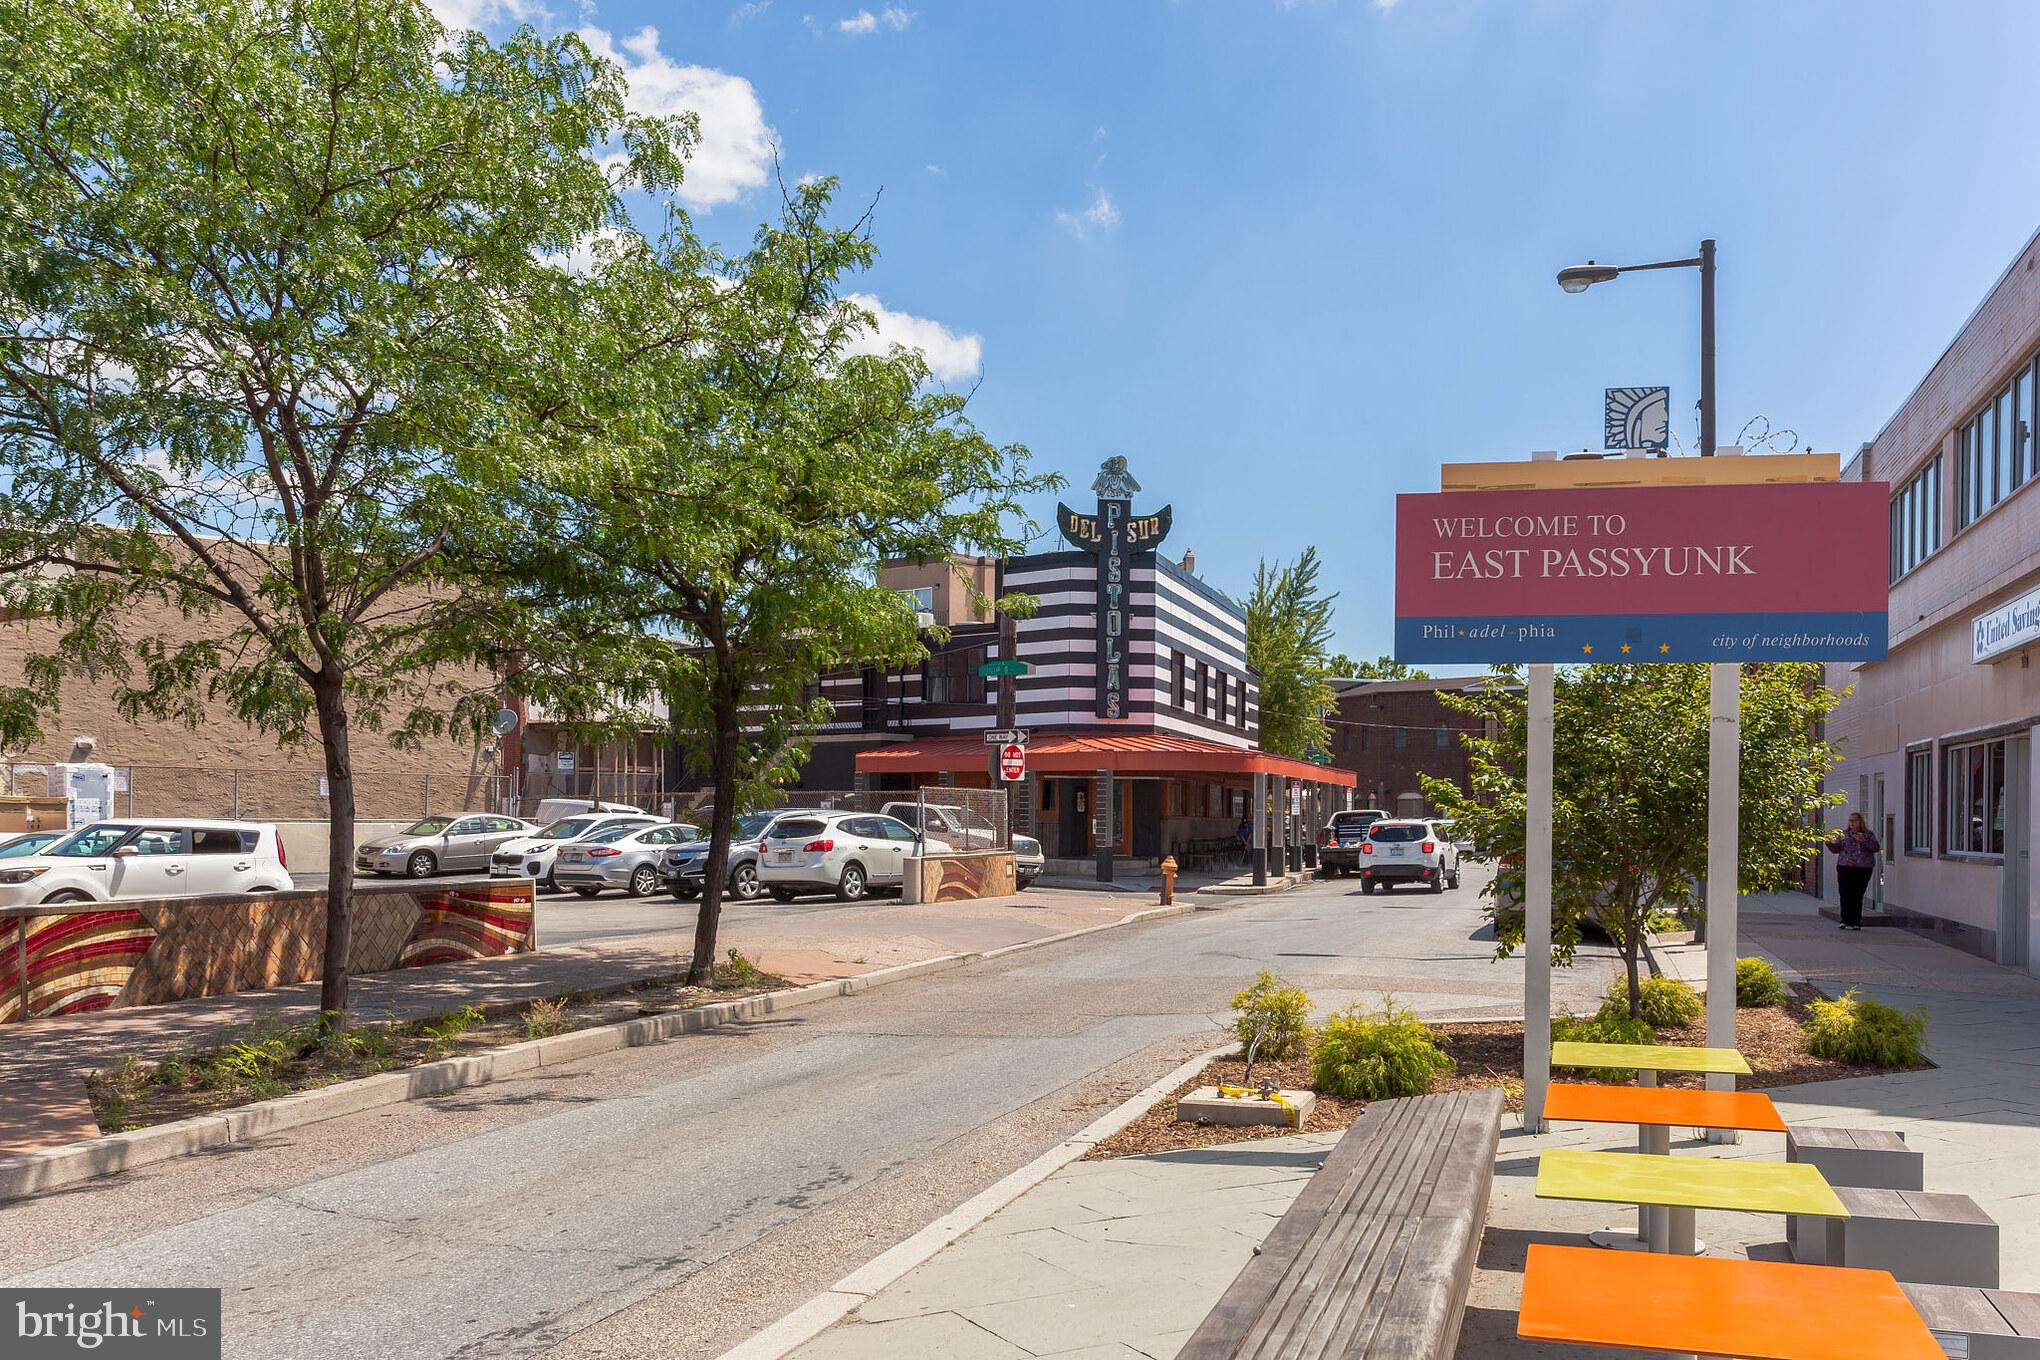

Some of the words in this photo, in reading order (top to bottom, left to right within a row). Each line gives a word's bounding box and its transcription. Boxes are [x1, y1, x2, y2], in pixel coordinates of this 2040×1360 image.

[1070, 515, 1102, 543] DEL
[1126, 517, 1159, 543] SUR
[1432, 515, 1579, 539] WELCOME
[1587, 514, 1626, 536] TO
[1432, 550, 1530, 580] EAST
[1541, 545, 1757, 578] PASSYUNK
[1105, 502, 1122, 718] PISTOLAS
[1986, 612, 2010, 646] United
[2012, 600, 2040, 634] Saving
[1712, 634, 1738, 649] city
[1742, 634, 1759, 648] of
[1761, 633, 1870, 649] neighborhoods
